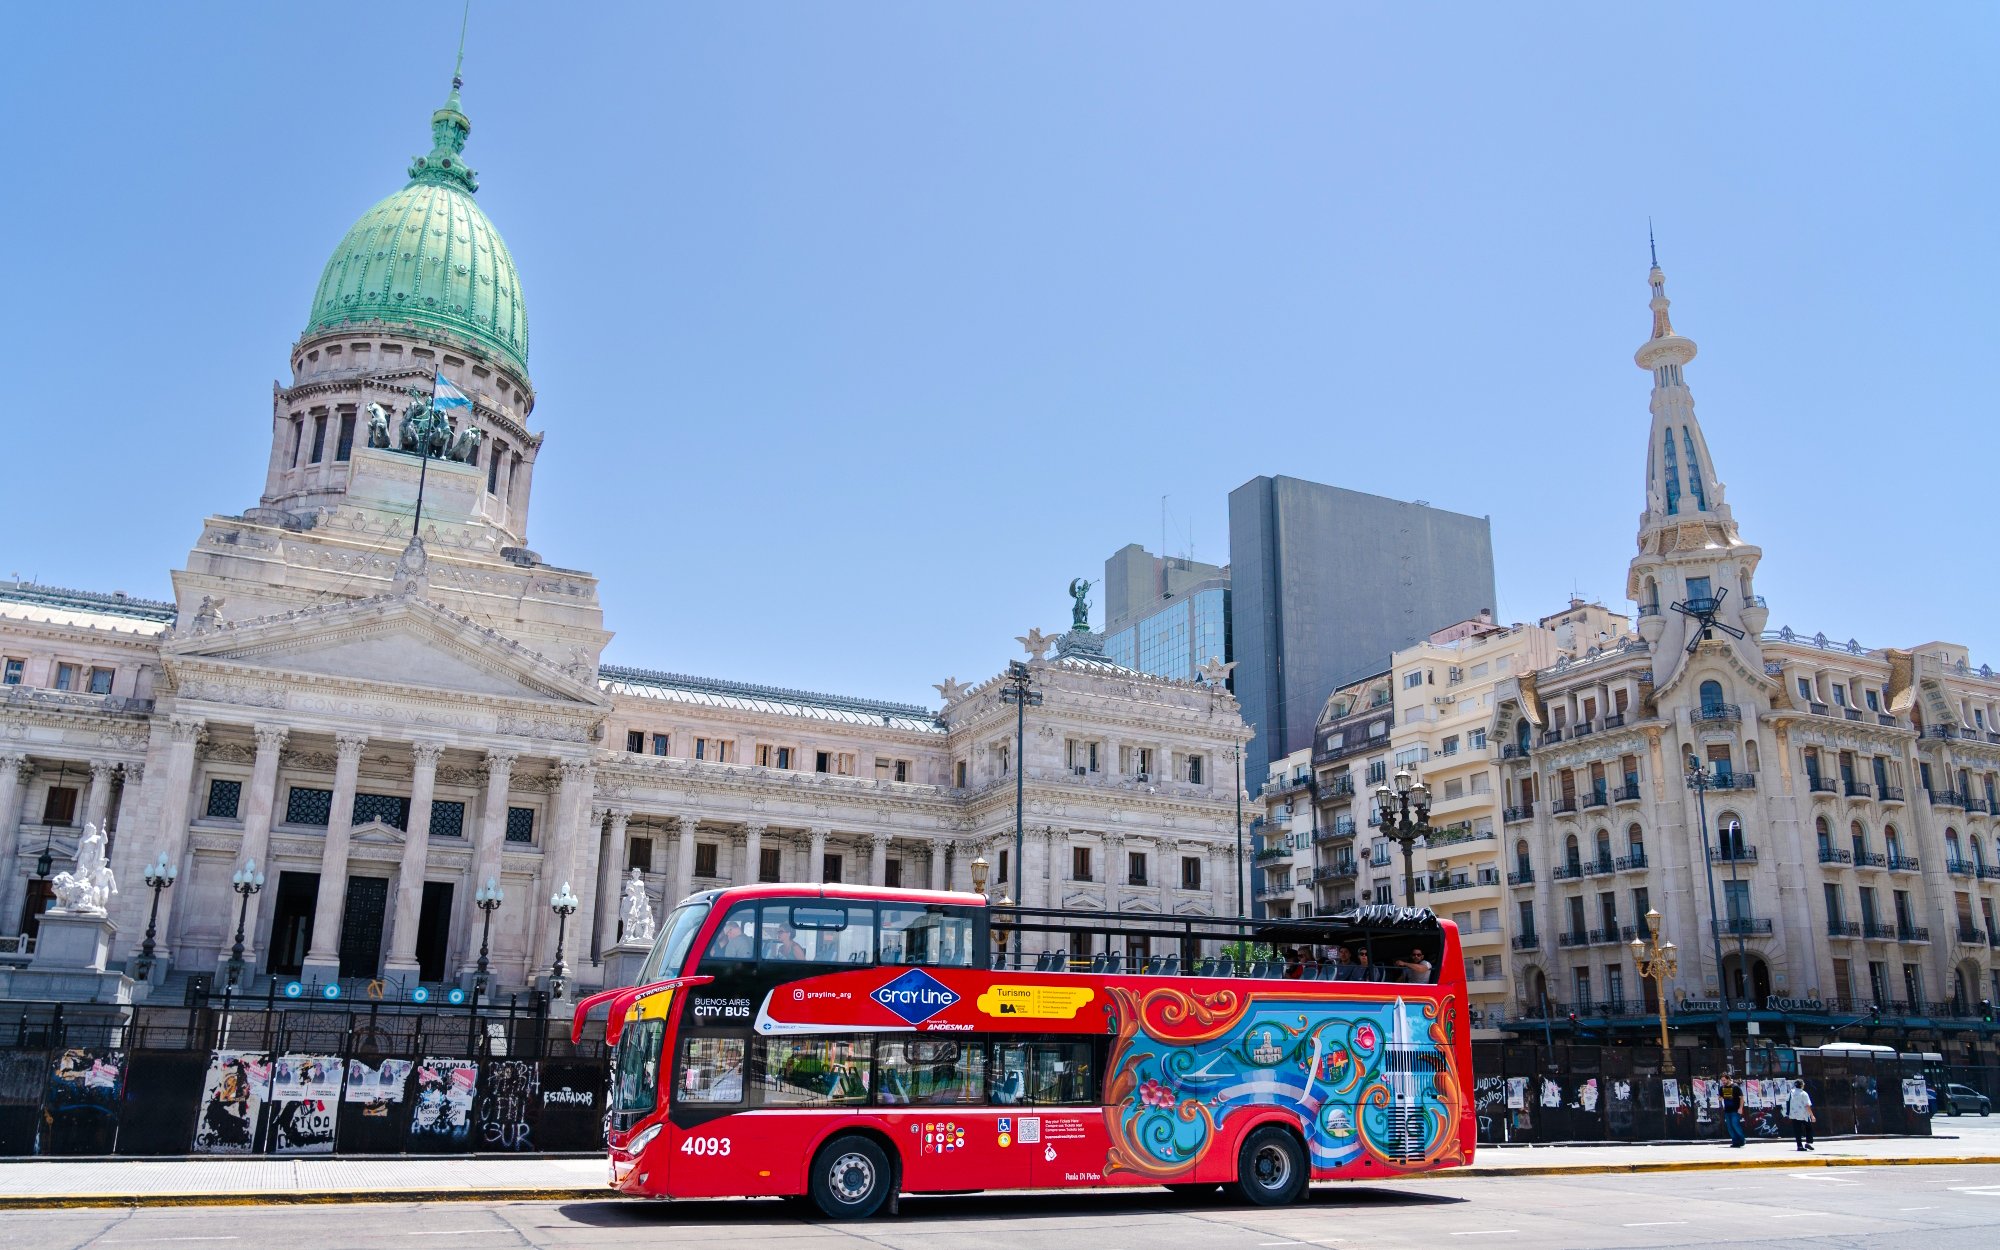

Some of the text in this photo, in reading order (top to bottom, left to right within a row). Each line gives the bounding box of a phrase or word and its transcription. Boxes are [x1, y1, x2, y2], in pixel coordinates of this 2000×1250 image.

[302, 698, 482, 729] CONGRESO NACIONAL
[806, 990, 852, 1000] grayline_arg
[879, 988, 953, 1005] Gray Line
[997, 988, 1031, 997] Turismo
[695, 998, 751, 1007] BUENOS AIRES
[1766, 995, 1823, 1012] MOLINO
[694, 1006, 750, 1017] CITY BUS
[1000, 1003, 1017, 1014] BA
[543, 1091, 593, 1108] ESTAFADOR
[681, 1136, 731, 1156] 4093
[1065, 1172, 1079, 1181] Paula
[1086, 1172, 1101, 1181] Pietro
